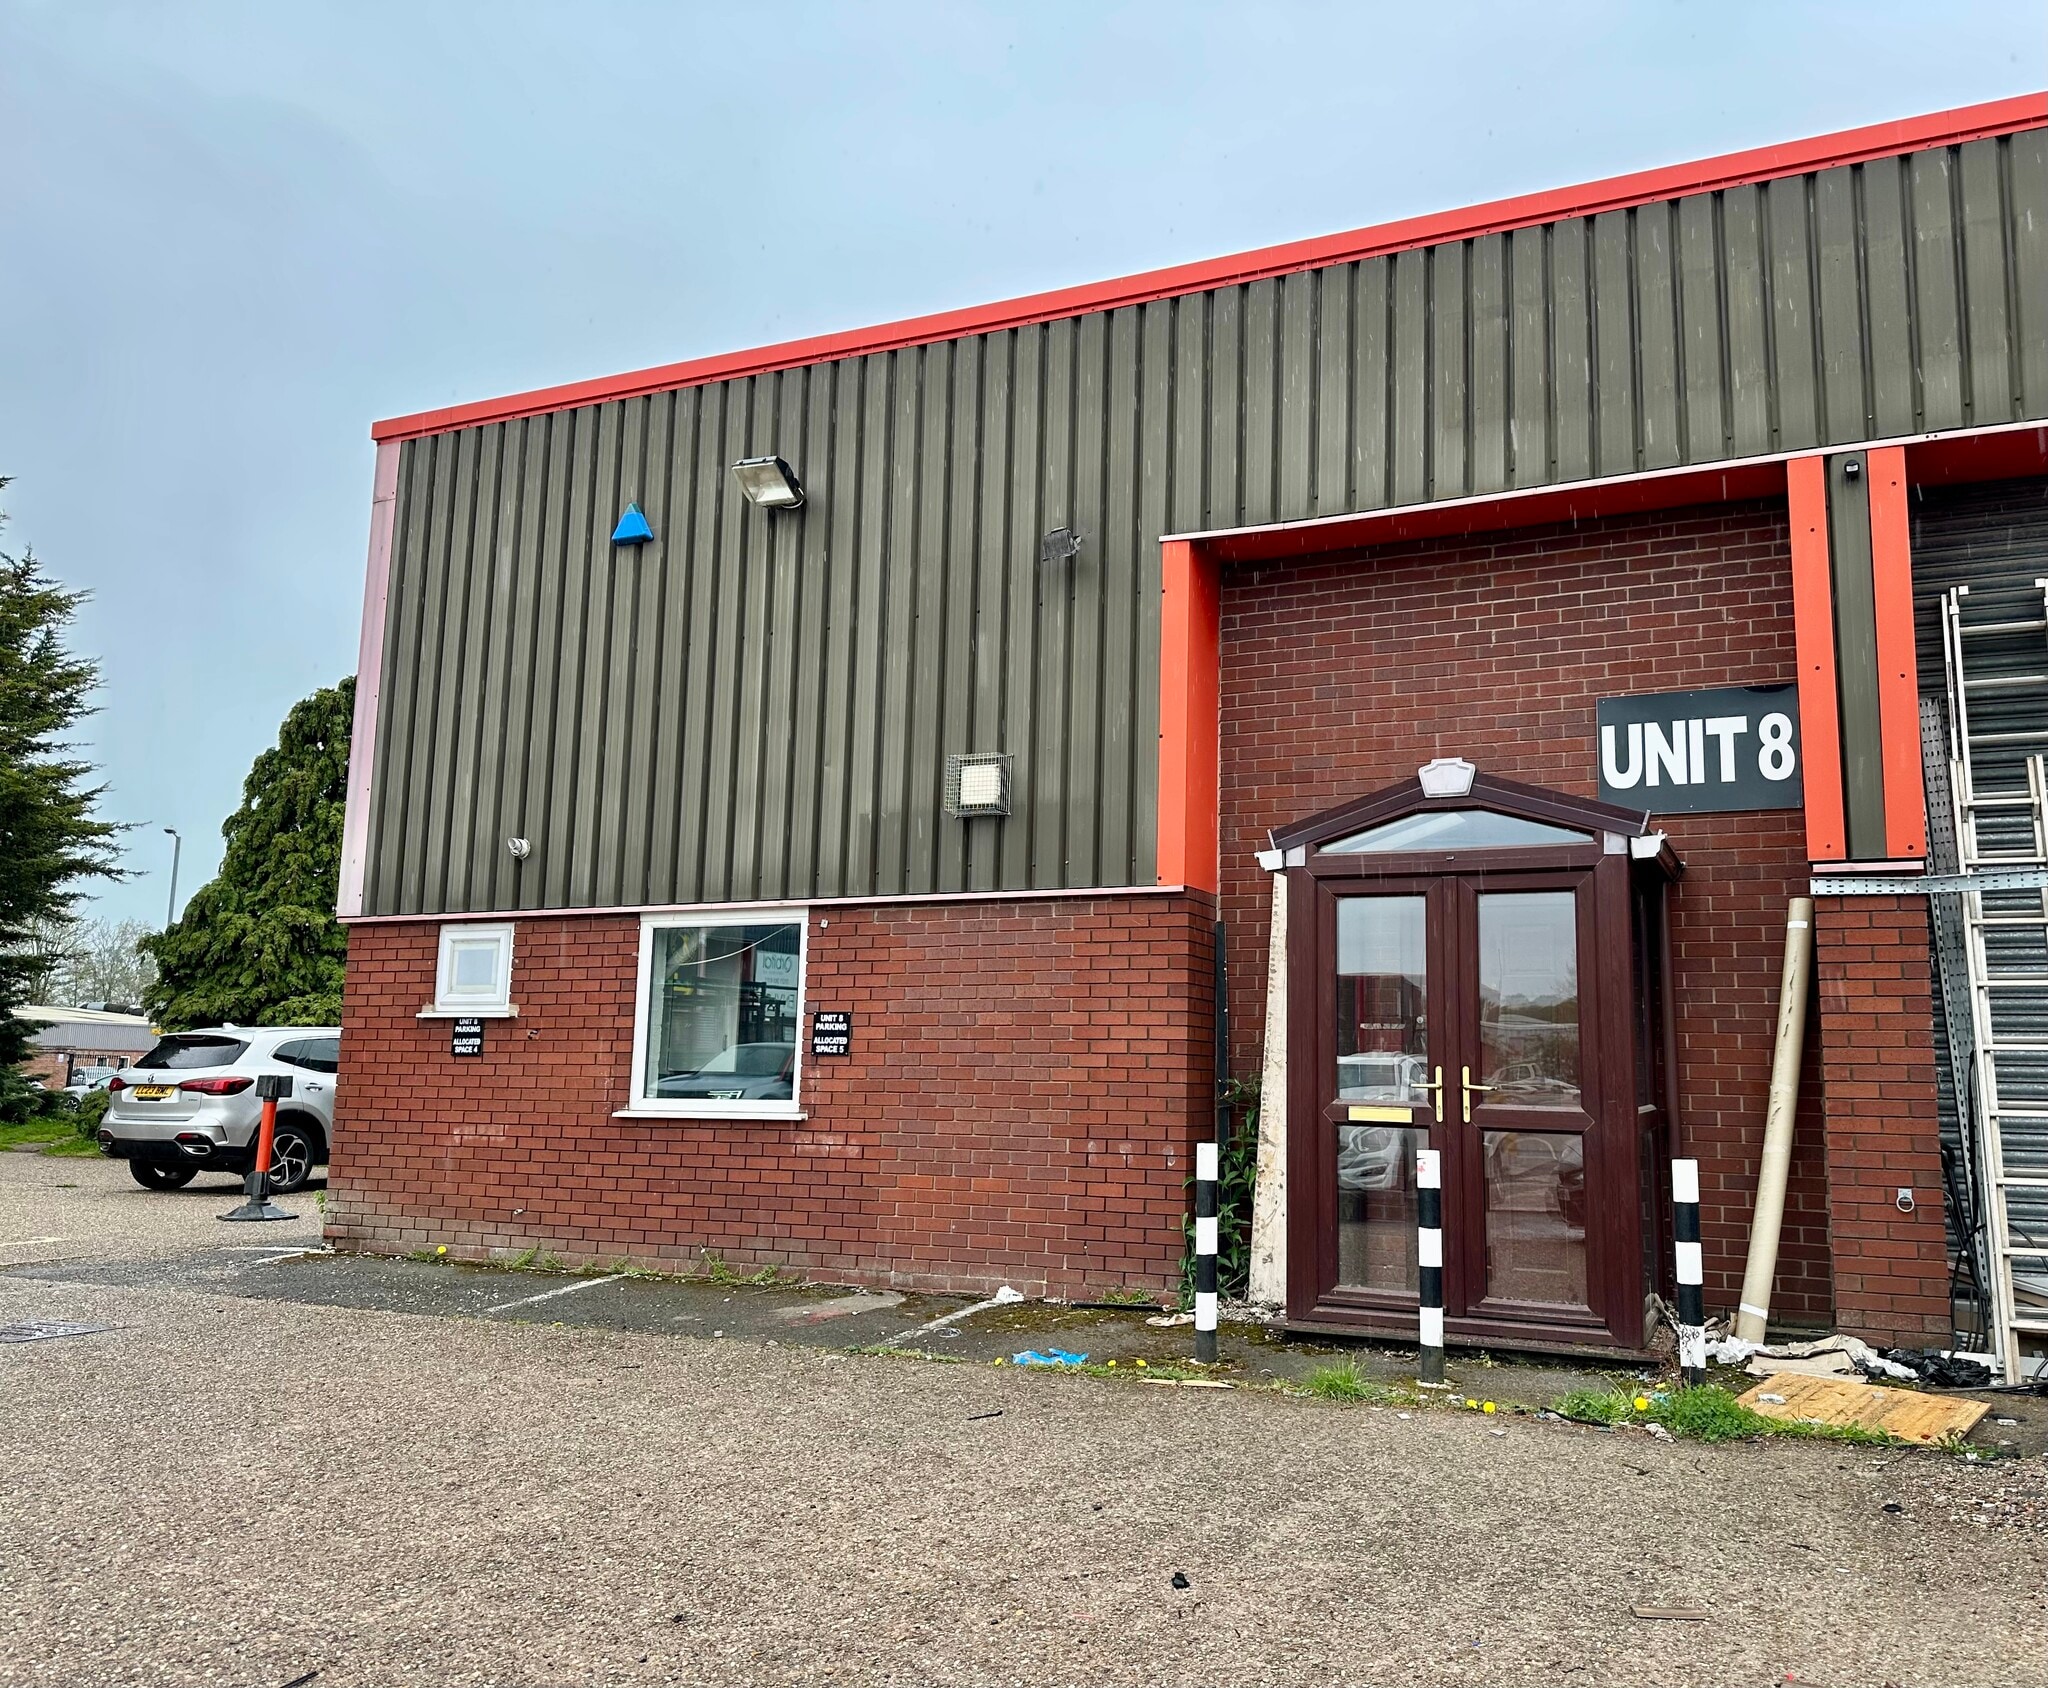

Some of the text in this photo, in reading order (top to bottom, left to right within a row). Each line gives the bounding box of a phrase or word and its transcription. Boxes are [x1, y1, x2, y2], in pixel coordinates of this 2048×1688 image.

[1601, 712, 1796, 789] UNIT 8
[820, 1014, 844, 1022] UNIT 8
[455, 1025, 481, 1033] PARKING
[453, 1038, 481, 1046] ALLOCATED
[815, 1045, 845, 1053] SPACE 5
[135, 1085, 156, 1095] LC23
